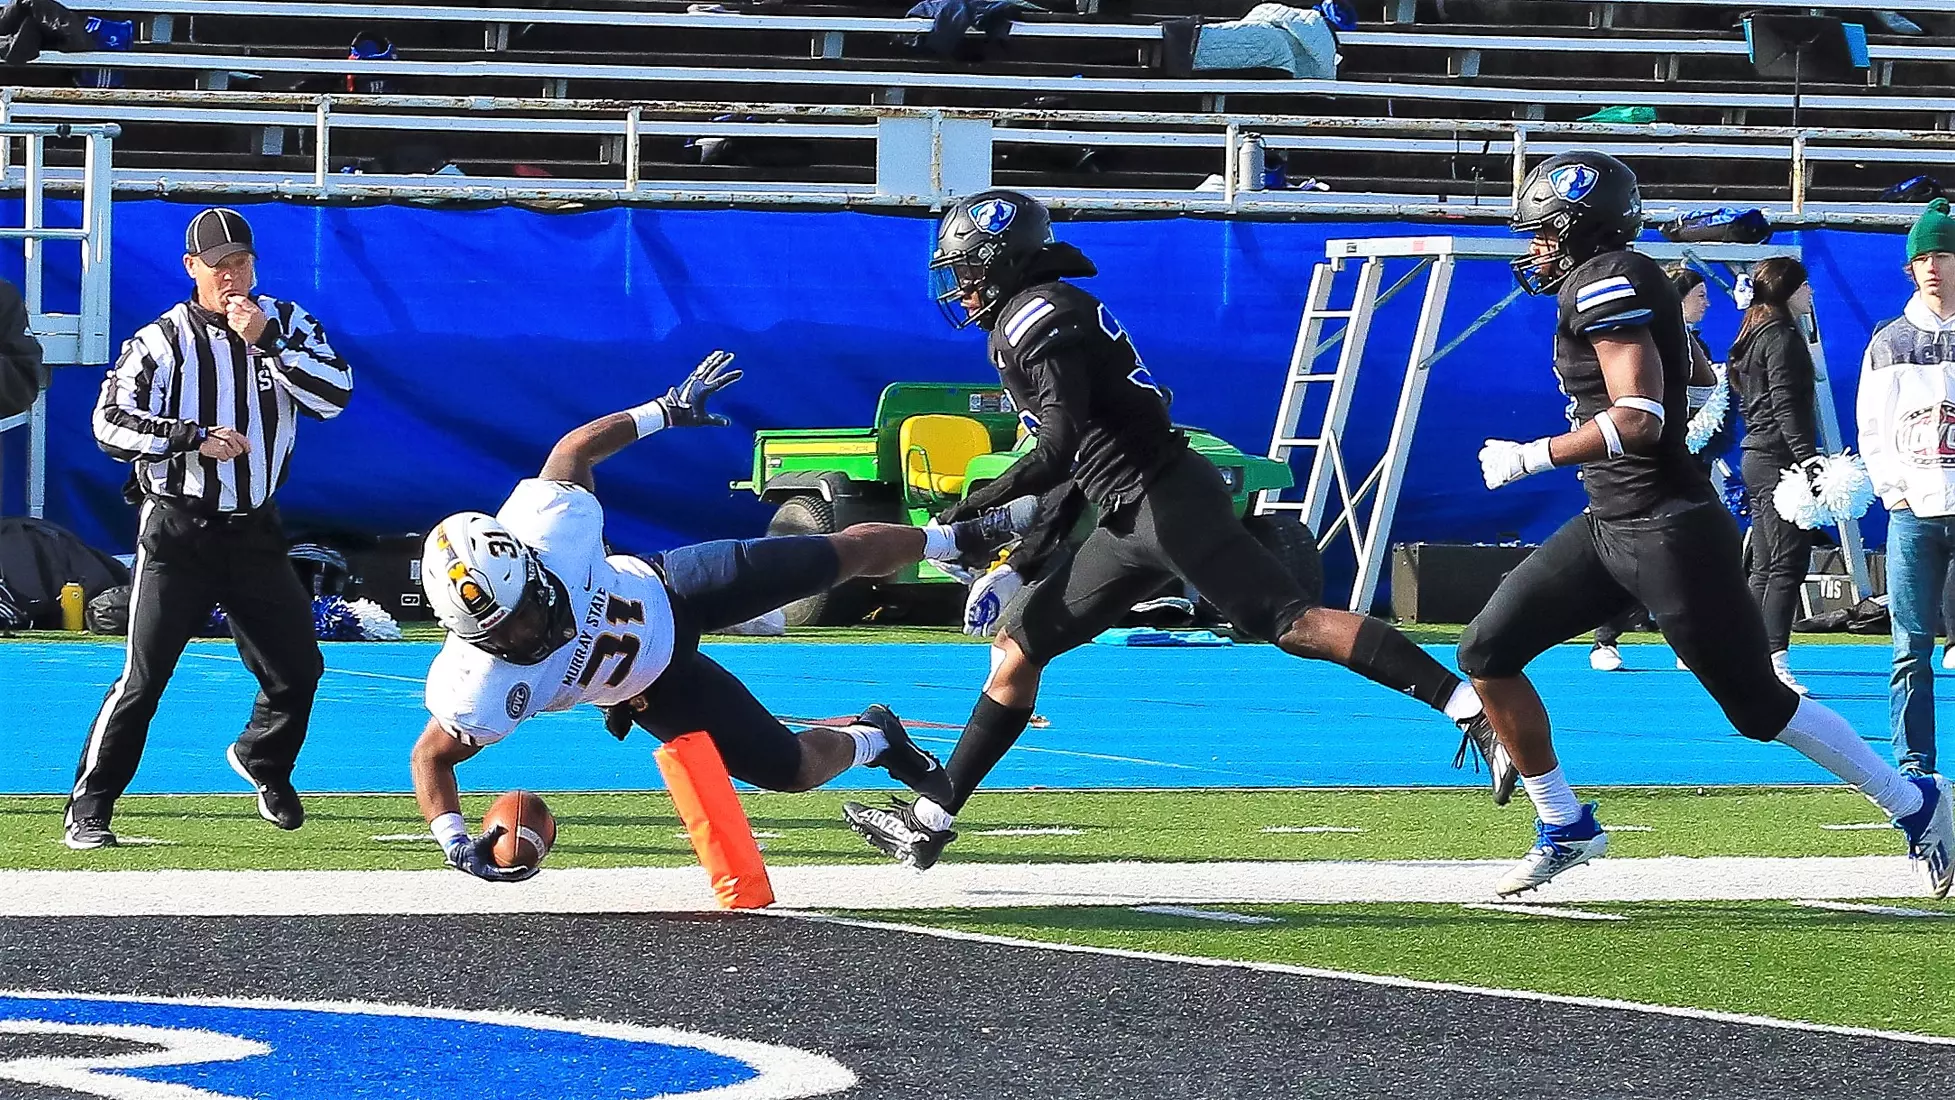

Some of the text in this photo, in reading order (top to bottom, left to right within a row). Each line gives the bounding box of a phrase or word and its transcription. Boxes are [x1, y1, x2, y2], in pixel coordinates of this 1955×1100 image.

[258, 369, 272, 391] S
[481, 531, 518, 559] 31
[562, 587, 606, 686] MURRAY STATE
[576, 592, 645, 689] 31
[512, 690, 524, 711] OVC
